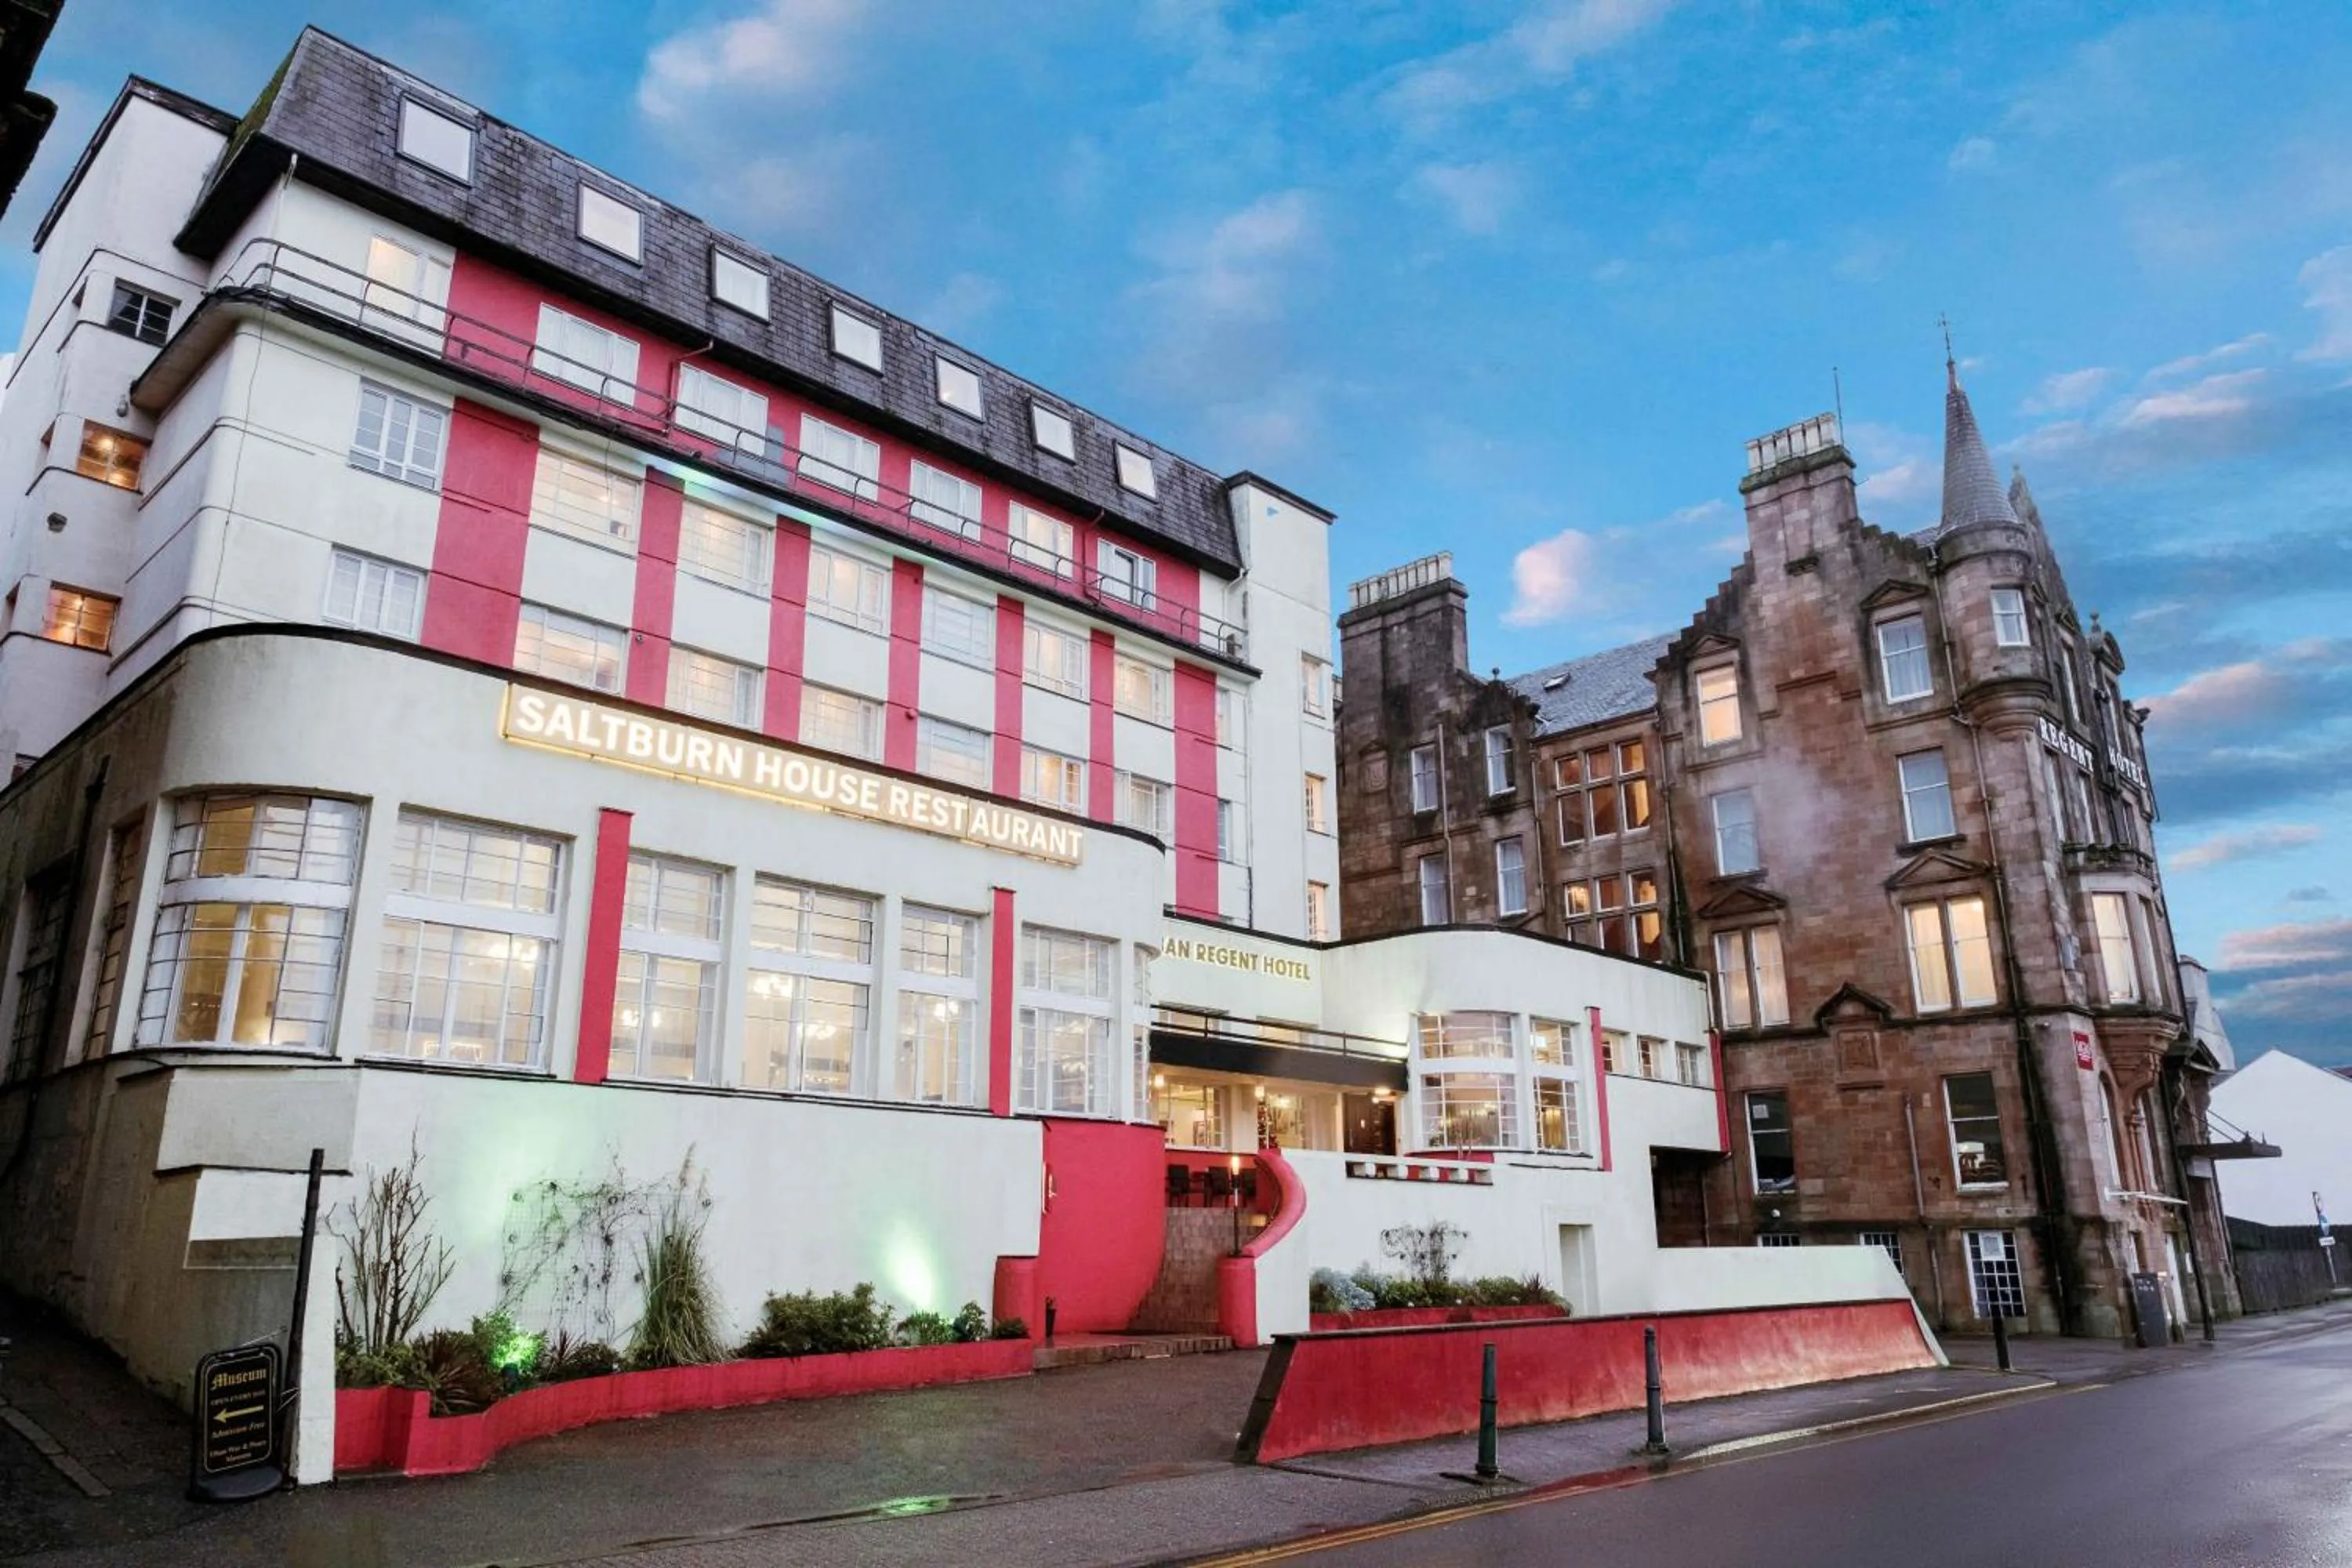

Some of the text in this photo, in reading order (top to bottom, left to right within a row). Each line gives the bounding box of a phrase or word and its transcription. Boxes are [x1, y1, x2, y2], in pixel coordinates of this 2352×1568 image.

[2039, 717, 2094, 773] REGENT
[2108, 746, 2146, 789] HOTEL
[514, 695, 1083, 859] SALTBURN HOUSE RESTAURANT
[1161, 935, 1310, 980] AN REGENT HOTEL
[210, 1368, 267, 1391] Museum
